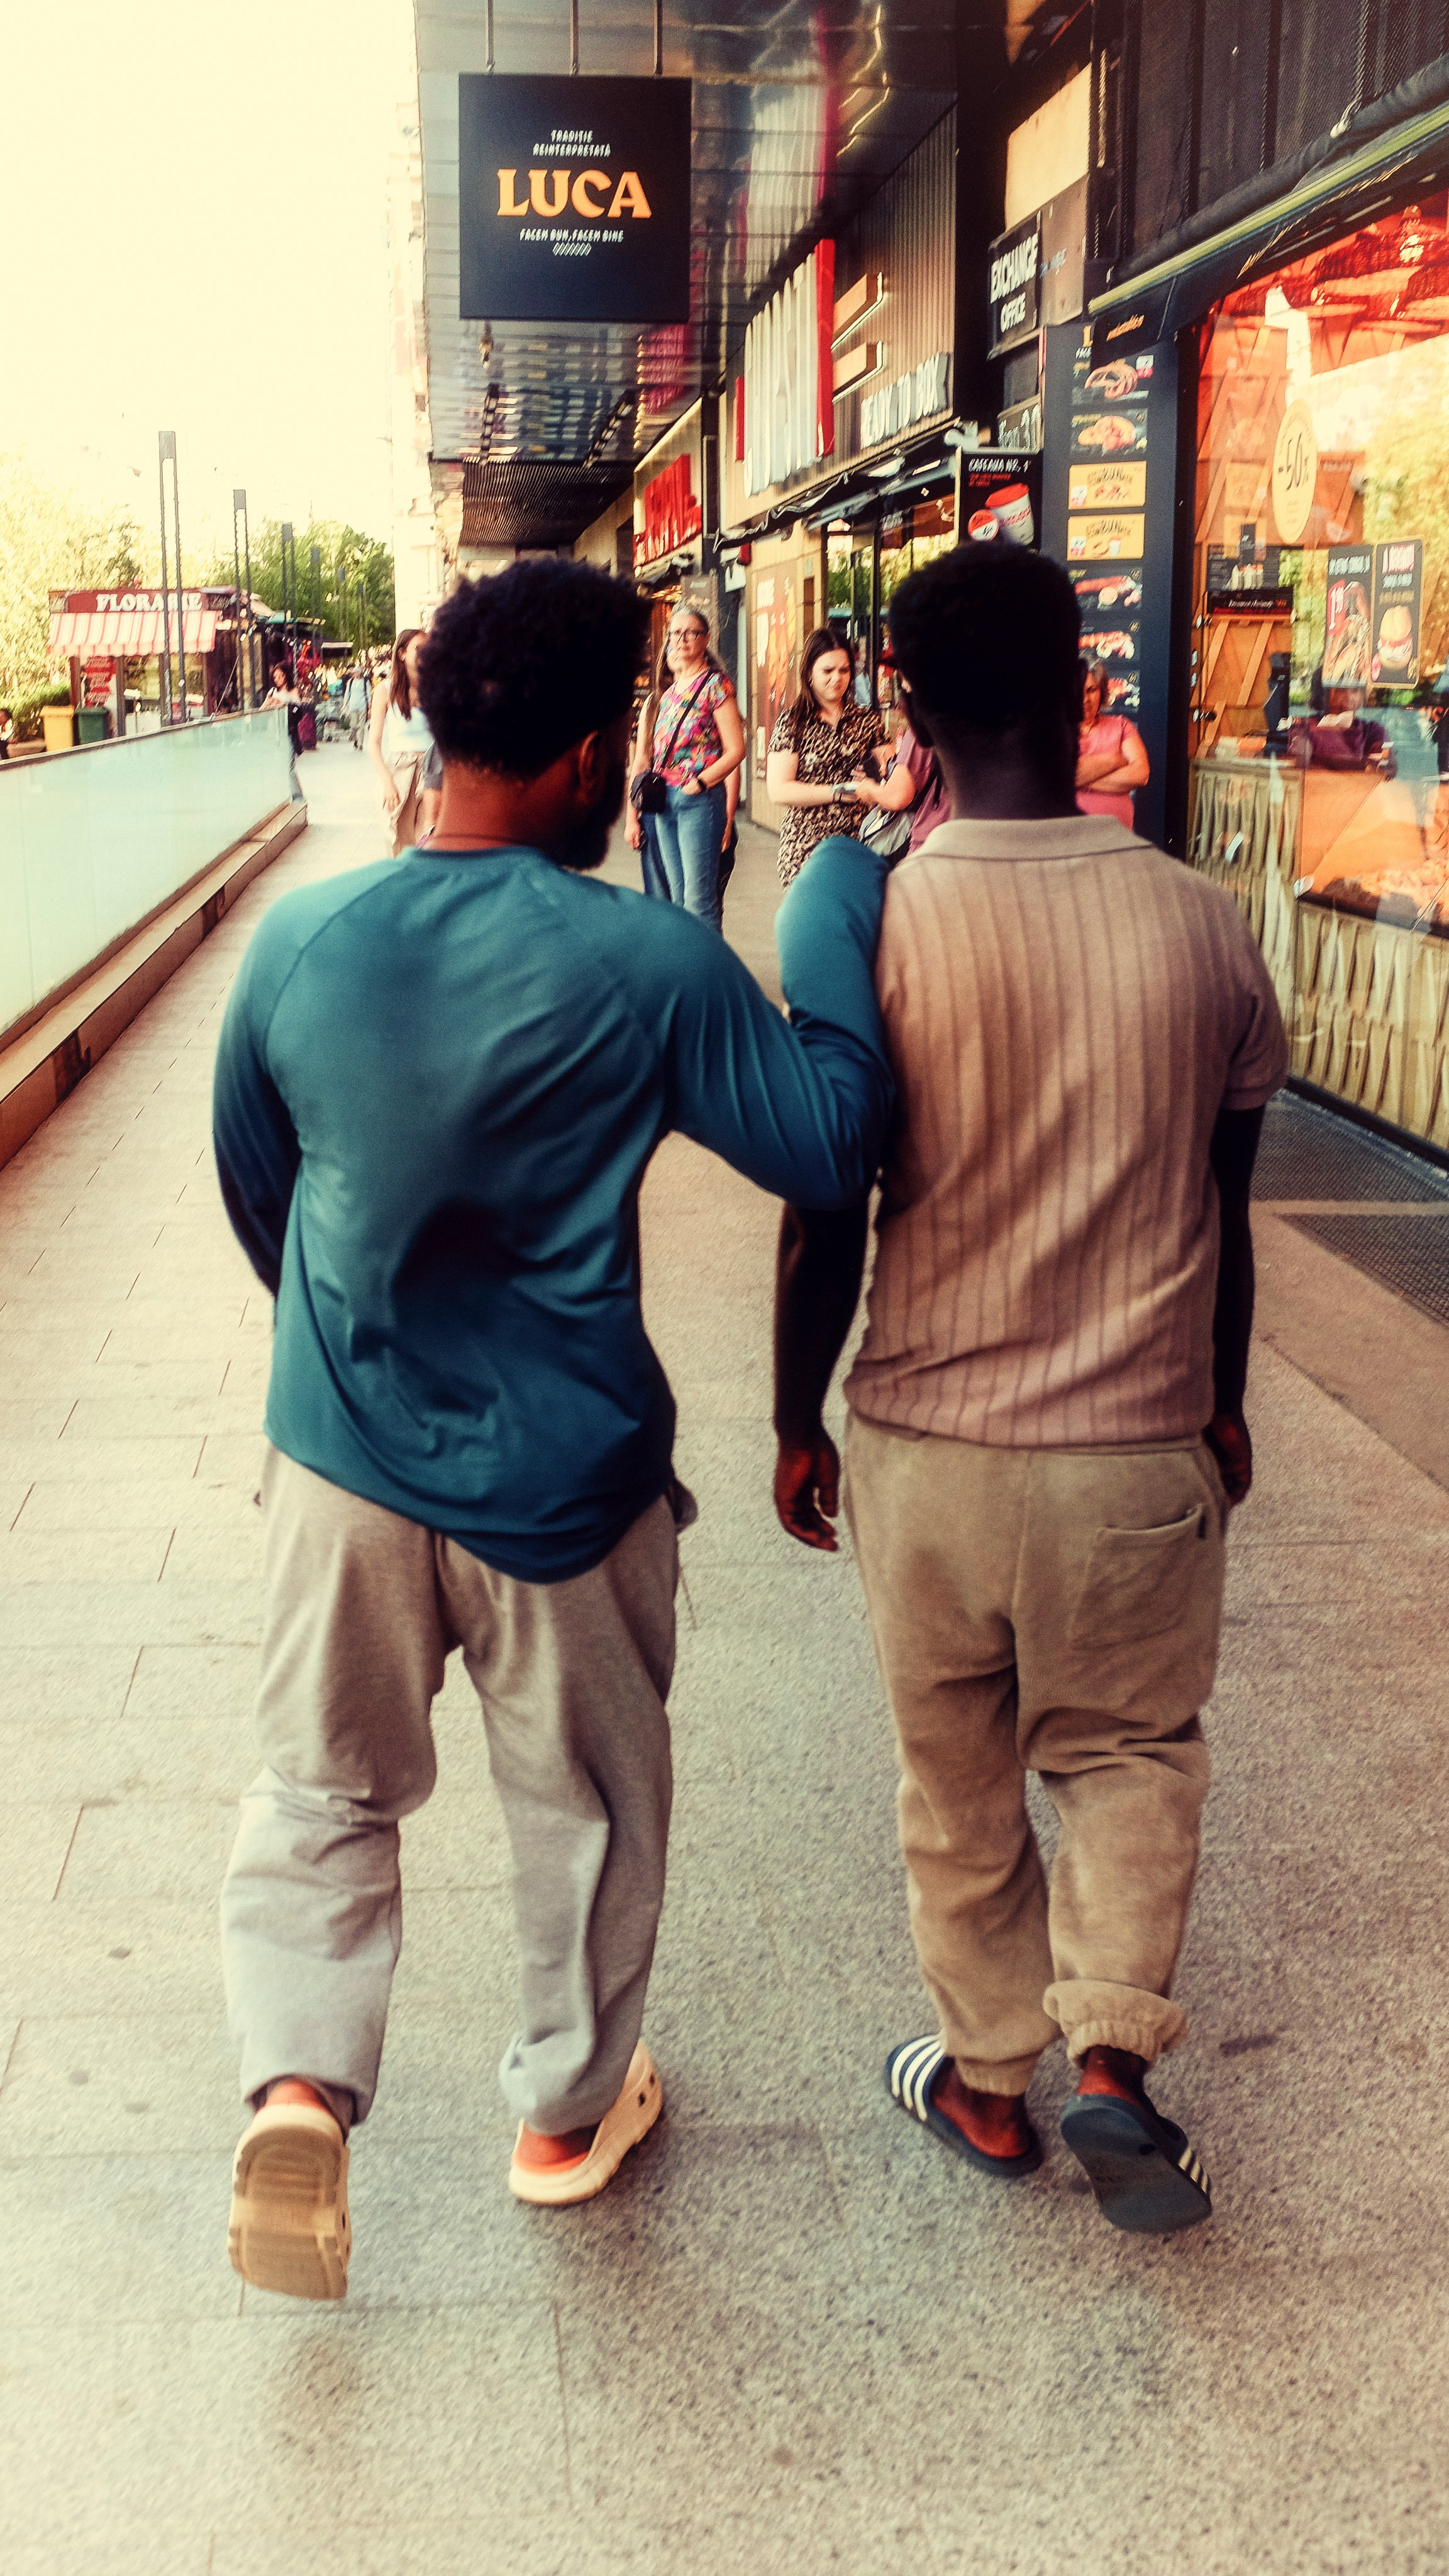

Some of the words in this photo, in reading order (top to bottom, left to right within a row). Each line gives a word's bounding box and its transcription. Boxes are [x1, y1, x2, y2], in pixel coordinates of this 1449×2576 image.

[497, 169, 652, 219] LUCA
[519, 228, 548, 242] FACEM
[572, 229, 601, 242] FACEM
[602, 230, 624, 243] BINE
[991, 233, 1038, 304] EXCHANGE
[1001, 291, 1026, 333] OFFICE
